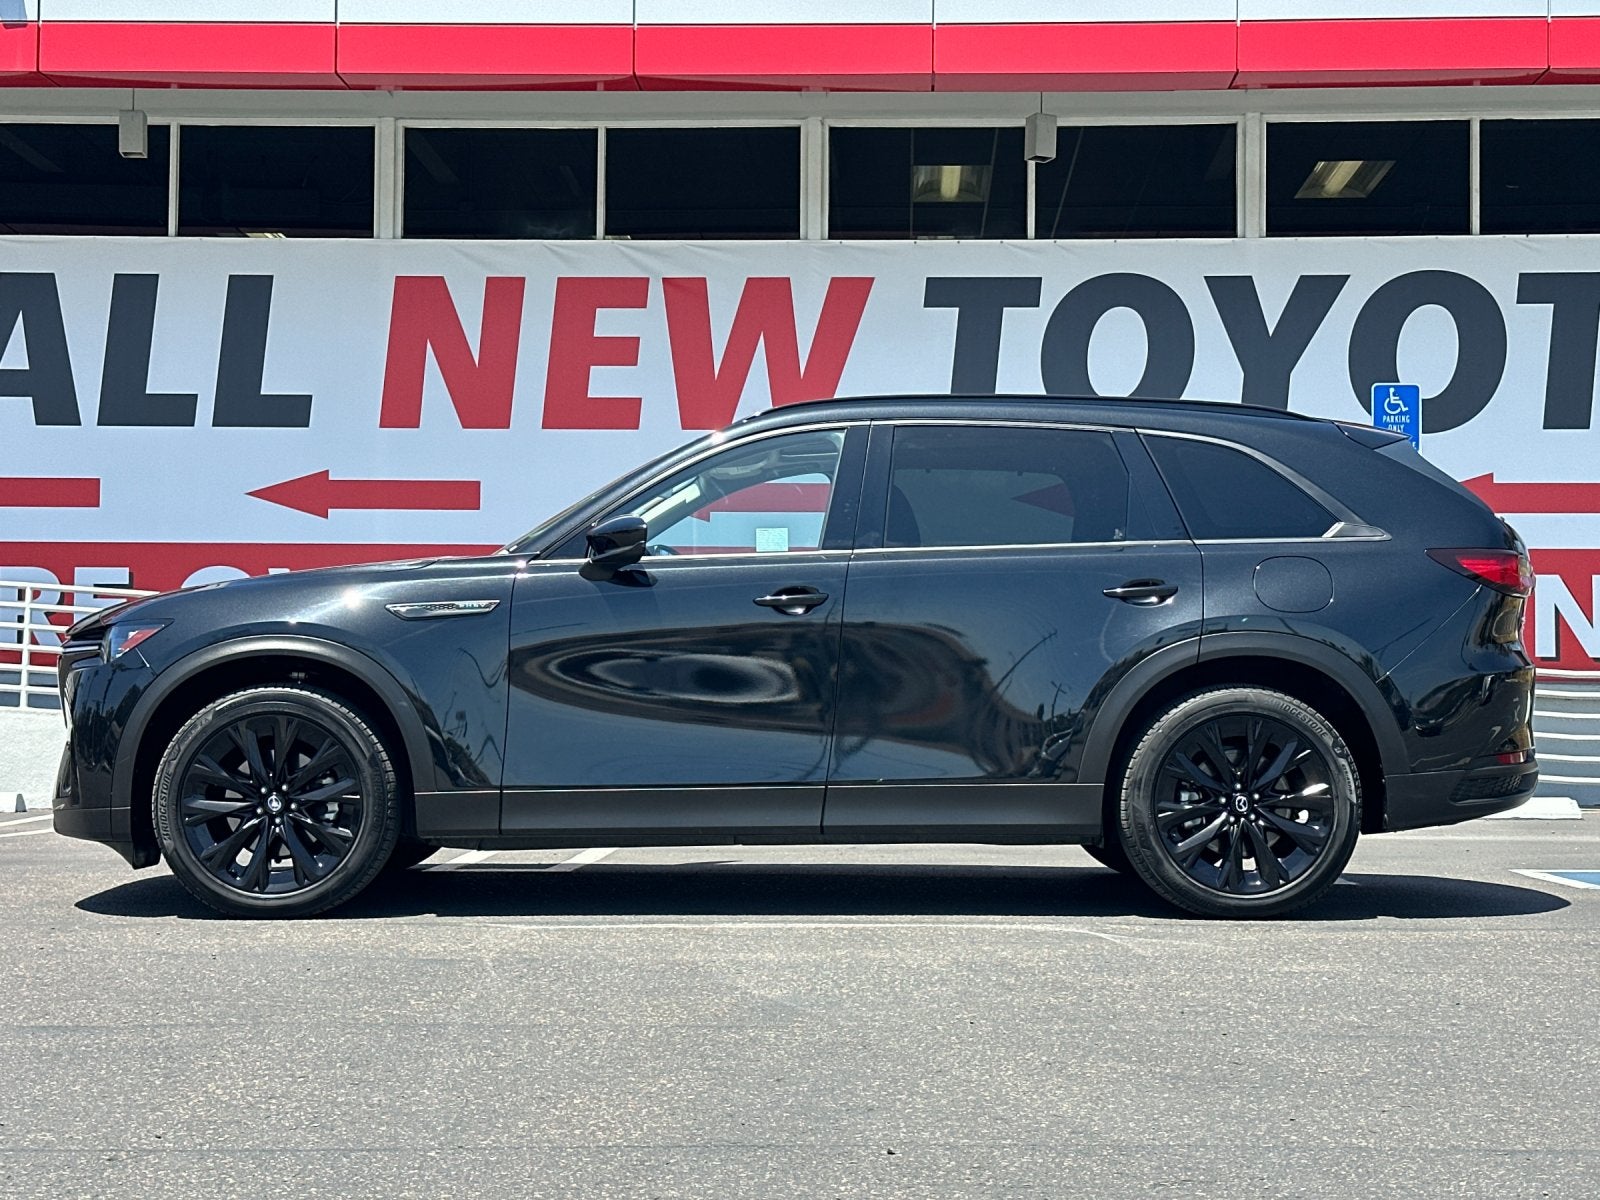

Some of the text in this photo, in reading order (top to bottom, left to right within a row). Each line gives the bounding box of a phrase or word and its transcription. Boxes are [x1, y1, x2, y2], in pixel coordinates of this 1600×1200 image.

[0, 269, 1600, 433] ALL NEW TOYOT
[1383, 415, 1410, 424] PARKING
[1388, 424, 1405, 432] ONLY
[159, 770, 173, 841] BRIDGESTONE
